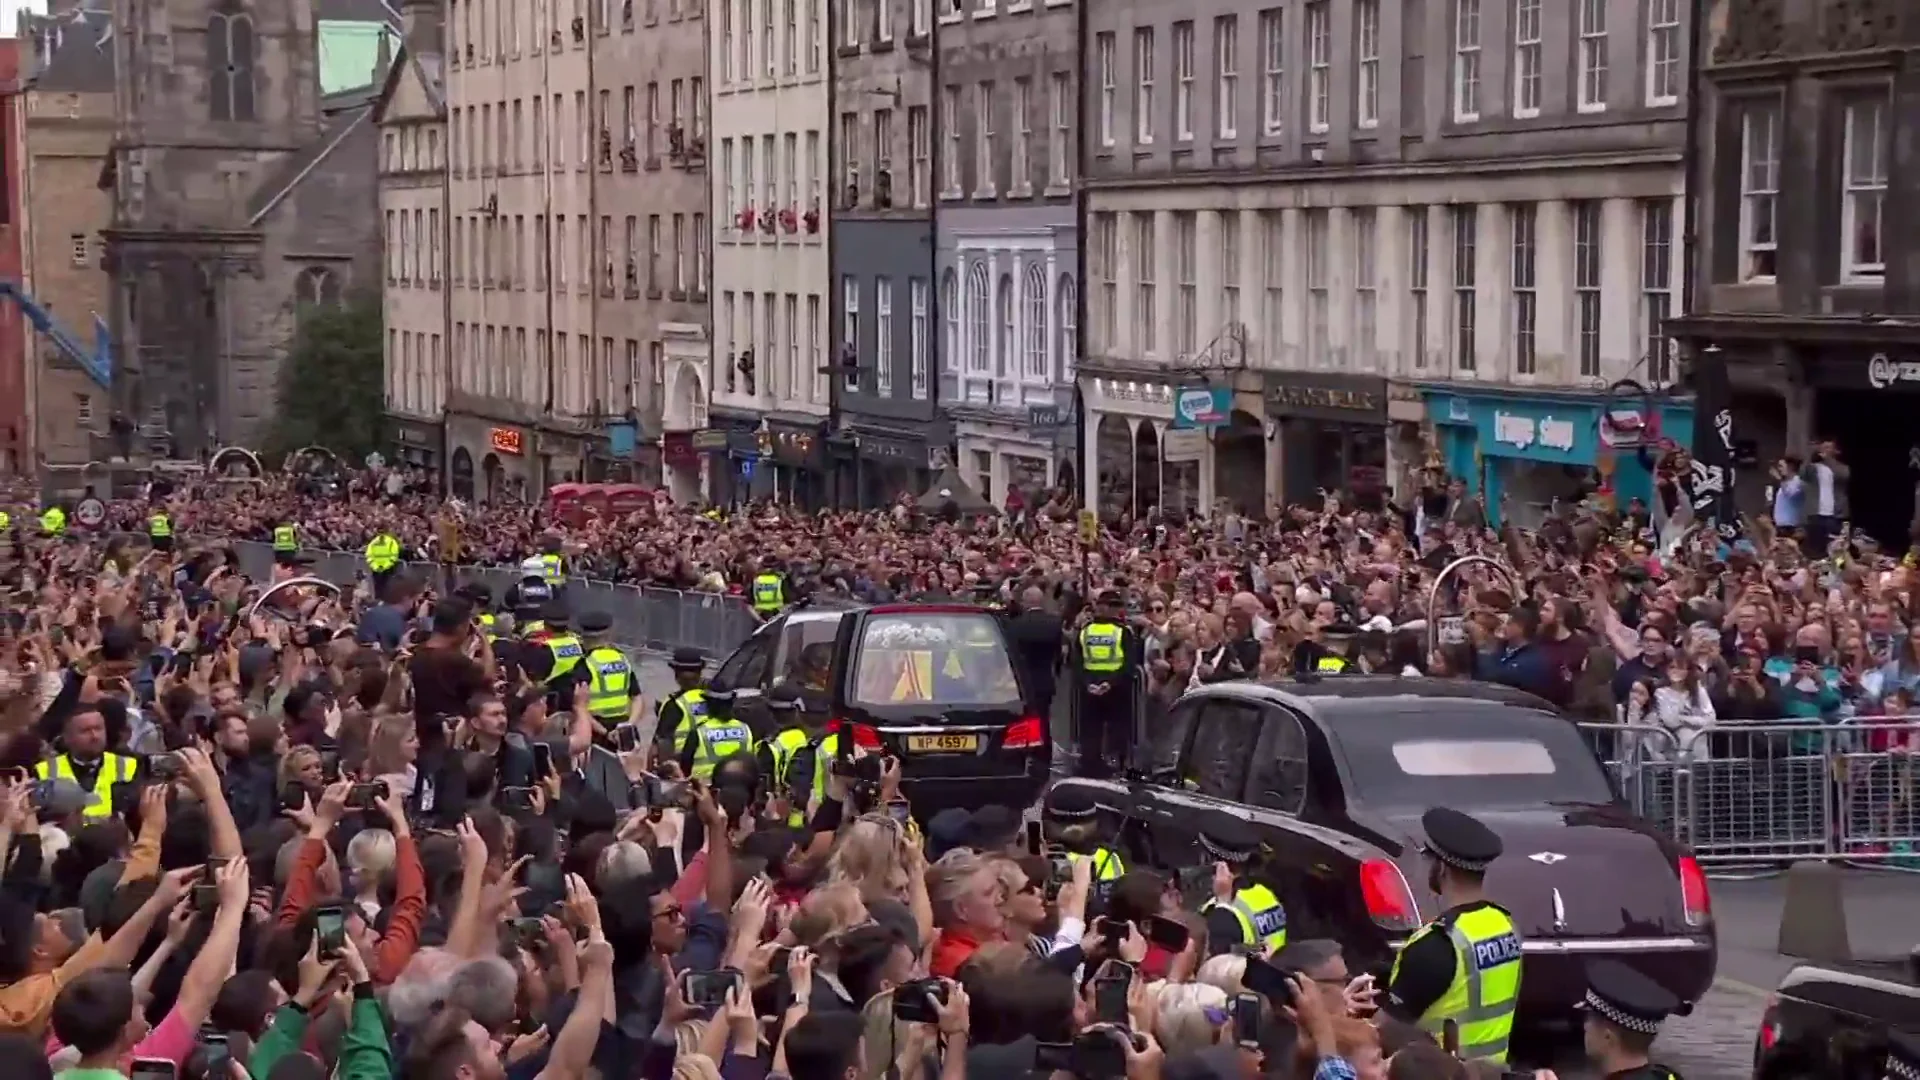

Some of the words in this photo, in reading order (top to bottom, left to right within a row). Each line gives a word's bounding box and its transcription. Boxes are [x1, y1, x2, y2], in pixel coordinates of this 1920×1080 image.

[1033, 412, 1055, 424] 166
[599, 661, 627, 673] POLICE
[706, 727, 745, 741] POLICE
[937, 736, 968, 748] 4597
